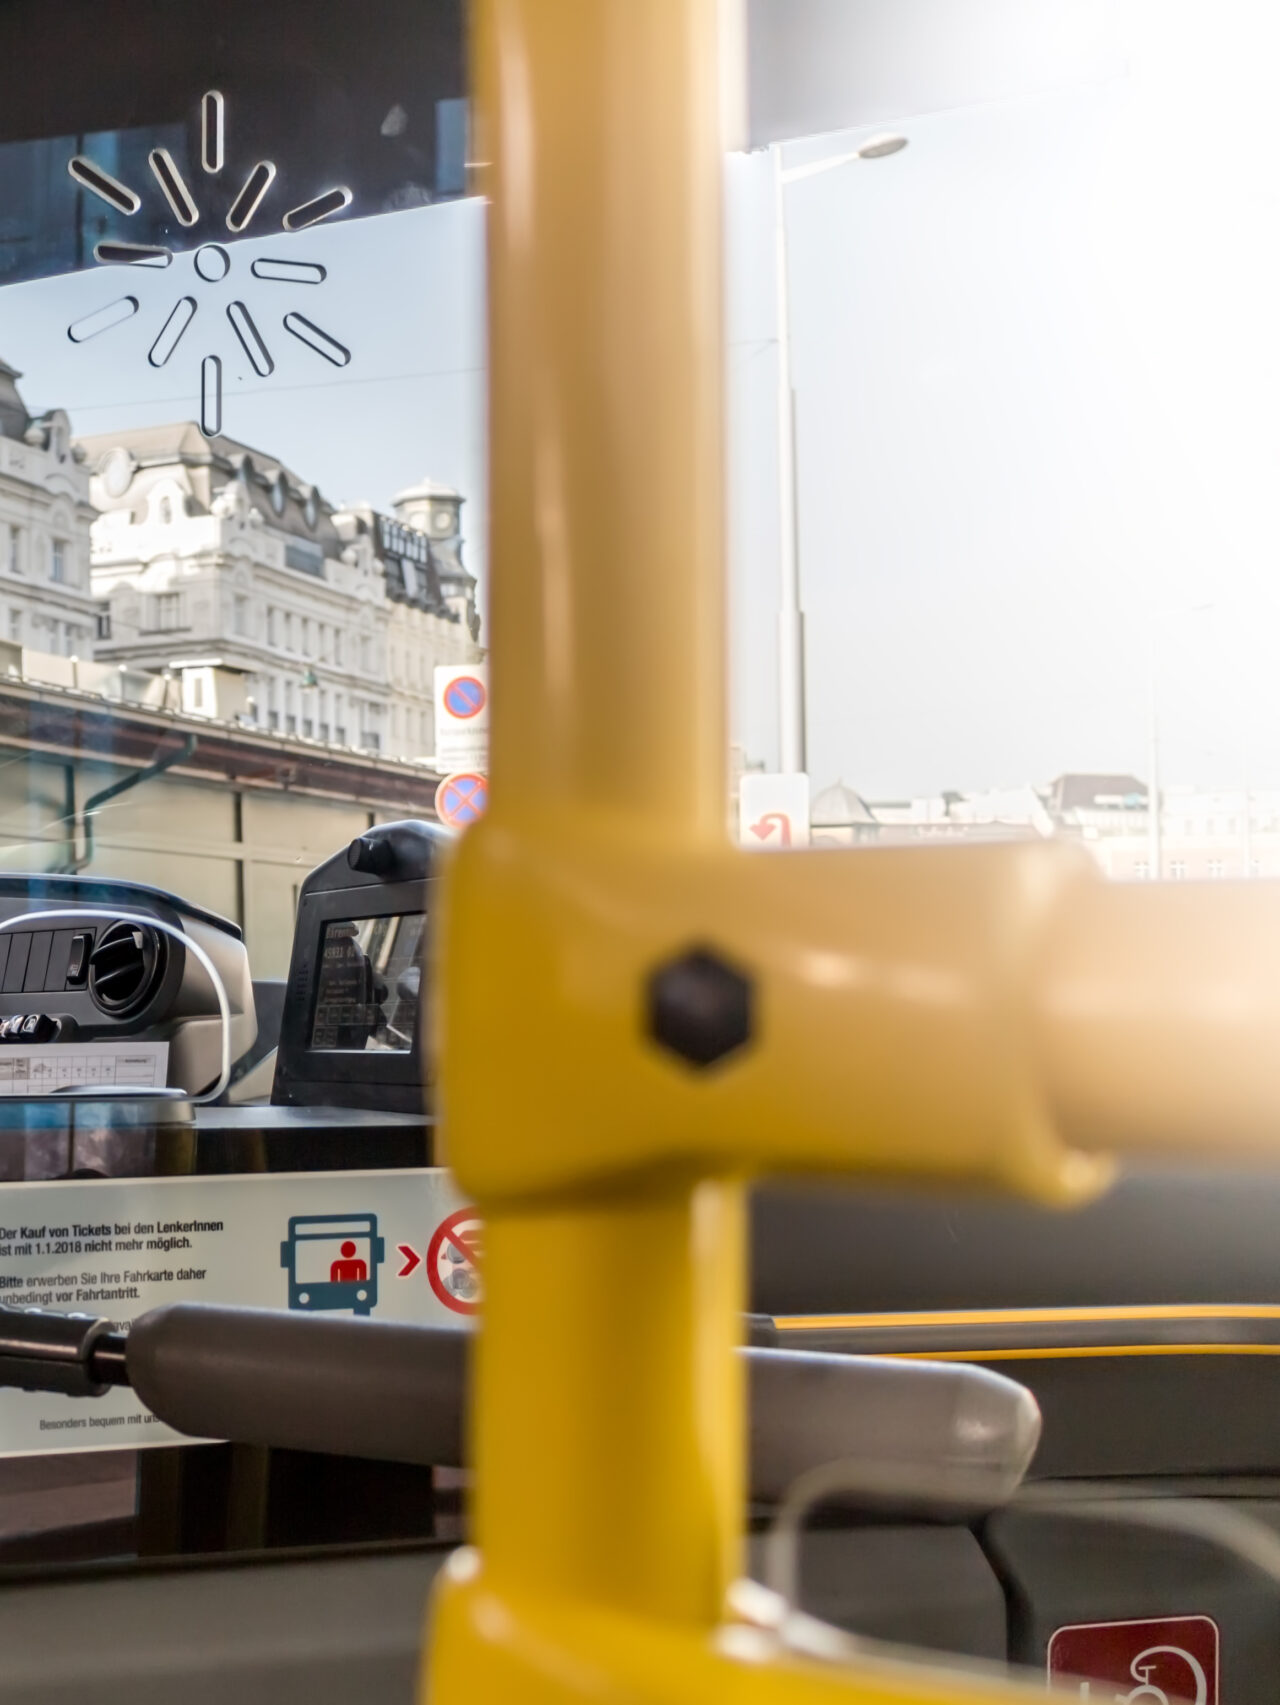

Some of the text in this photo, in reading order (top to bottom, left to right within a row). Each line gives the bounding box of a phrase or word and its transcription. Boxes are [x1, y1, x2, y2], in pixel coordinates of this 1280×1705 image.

[20, 1225, 46, 1239] Kauf
[49, 1227, 69, 1238] von
[72, 1224, 111, 1237] Tickets
[114, 1222, 131, 1235] bei
[134, 1222, 154, 1234] den
[157, 1220, 224, 1233] LenkerInnen
[0, 1236, 192, 1256] ist mit 1.1.2018 nicht mehr möglich.
[26, 1274, 78, 1287] erwerben
[81, 1272, 97, 1285] Sie
[100, 1271, 120, 1284] Ihre
[123, 1269, 174, 1283] Fahrkarte
[177, 1268, 207, 1280] daher
[0, 1287, 140, 1306] unbedingt vor Fahrtantritt.
[39, 1418, 87, 1431] Besonders
[89, 1416, 125, 1429] bequem
[127, 1414, 142, 1425] mit
